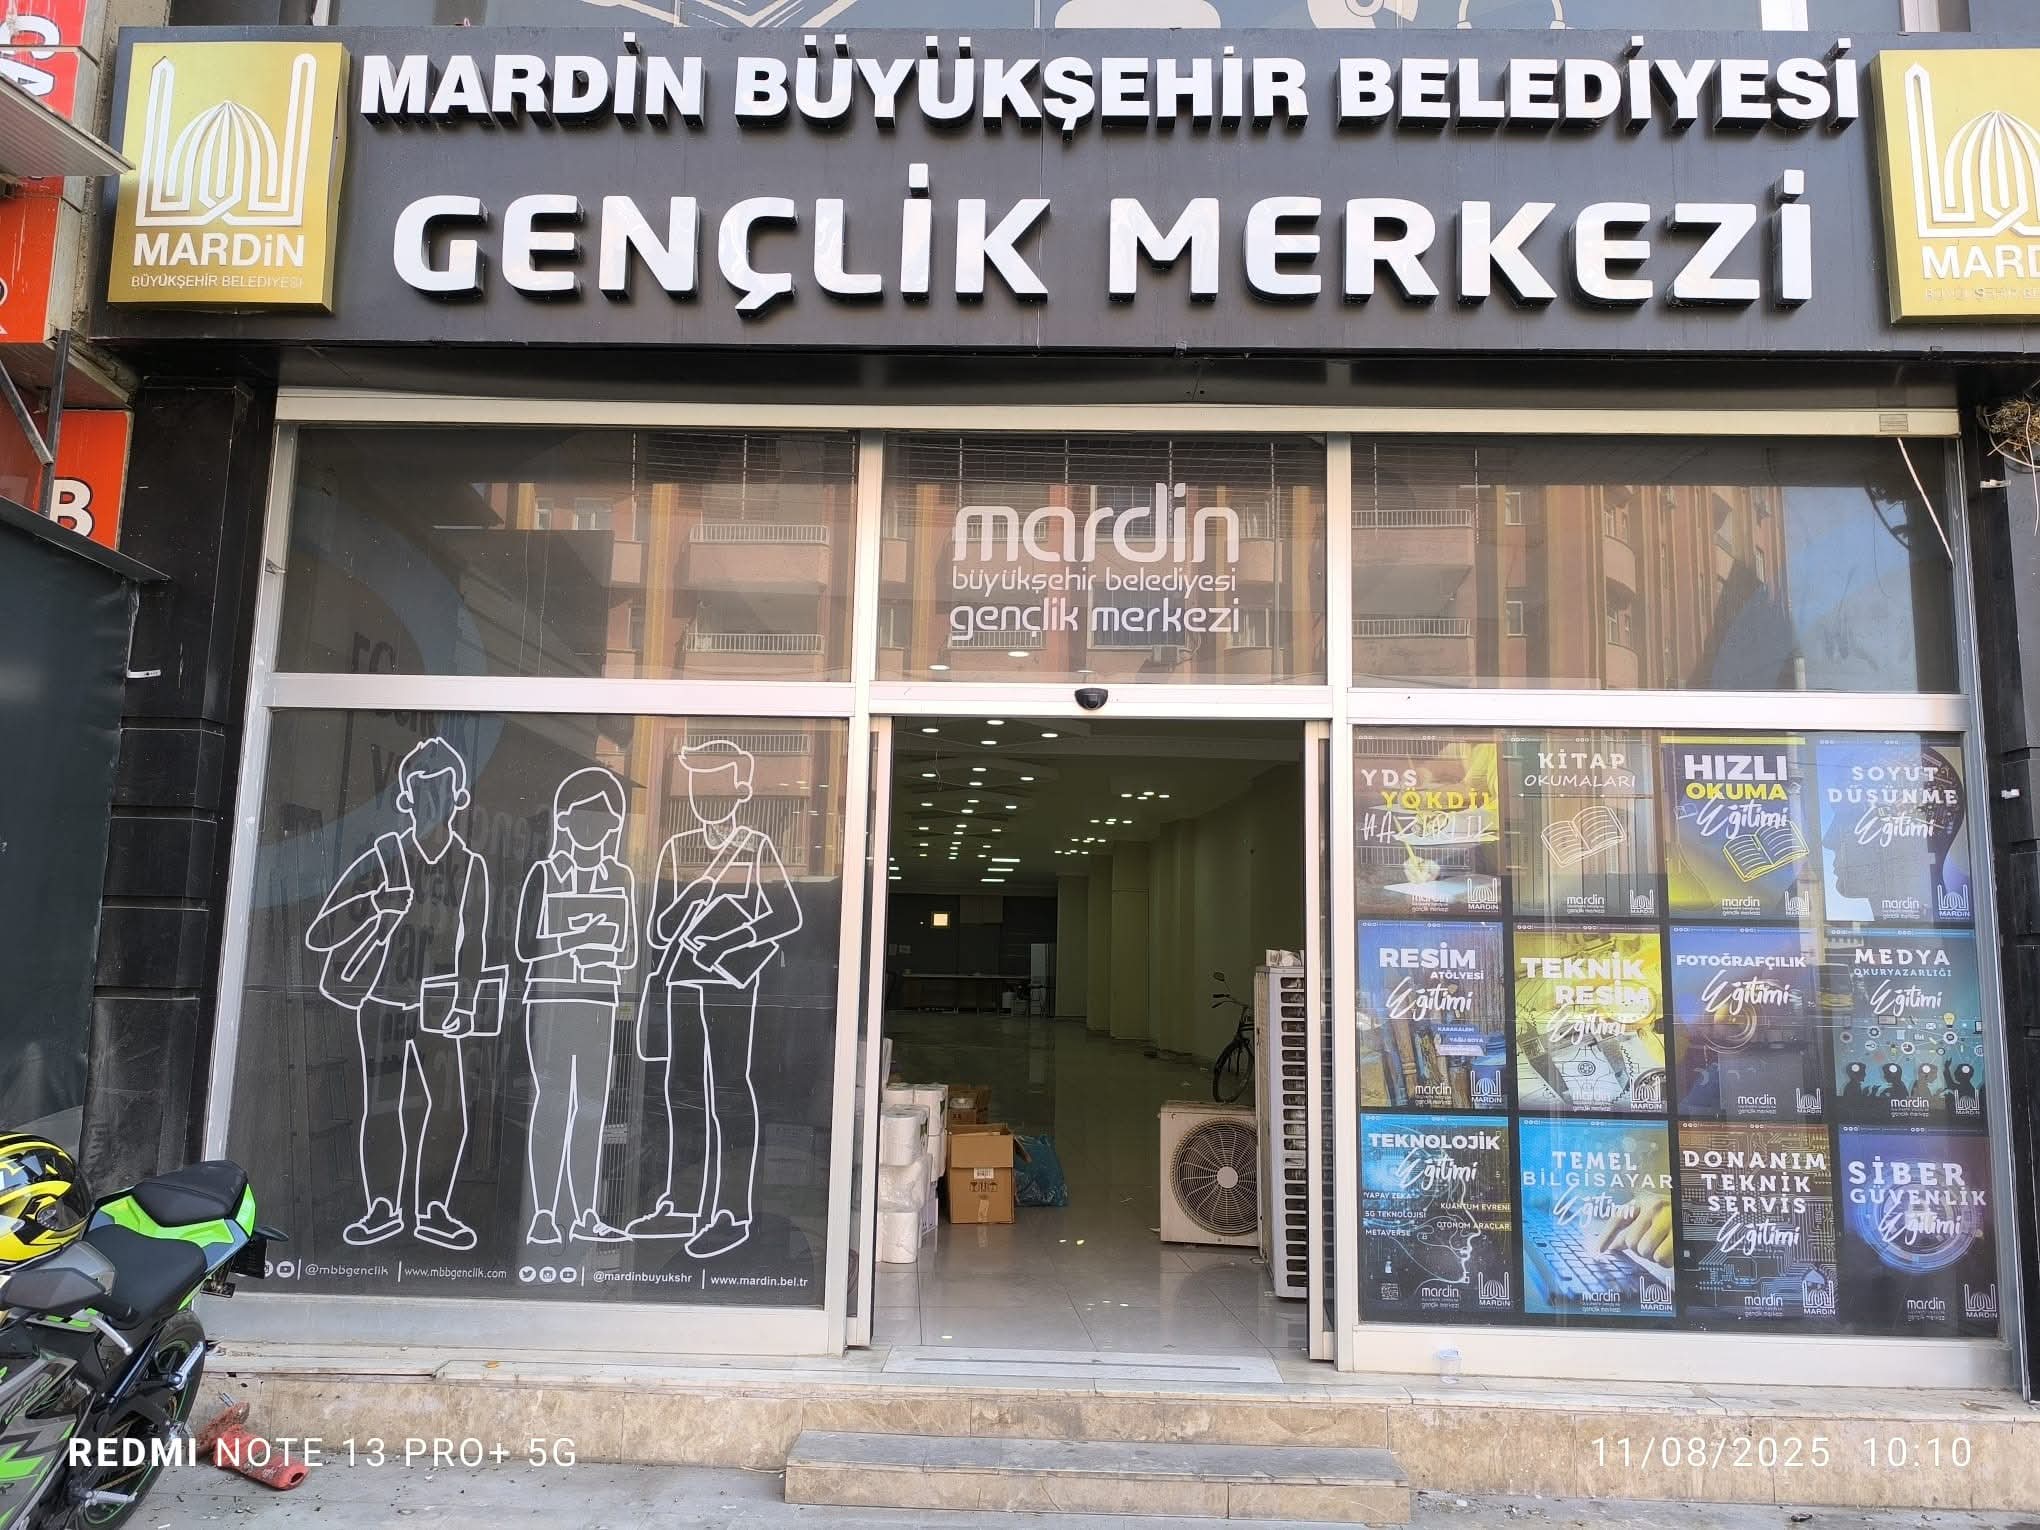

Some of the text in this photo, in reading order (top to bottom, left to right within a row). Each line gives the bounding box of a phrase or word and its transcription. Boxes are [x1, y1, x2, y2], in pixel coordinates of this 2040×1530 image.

[360, 31, 1859, 131] MARDİN BÜYÜKŞEHİR BELEDİYESİ
[393, 163, 1813, 314] GENÇLİK MERKEZİ
[131, 272, 218, 289] BÜYÜKŞEHİR
[952, 482, 1240, 563] mardin
[952, 566, 1237, 599] büyükşehir belediyesi
[950, 597, 1240, 640] gençlik merkezi
[1538, 748, 1627, 770] KİTAP
[1684, 754, 1789, 781] HIZLI
[1361, 769, 1418, 787] YDS
[1524, 774, 1636, 788] OKUMALARI
[1851, 766, 1939, 782] SOYUT
[1686, 782, 1790, 801] OKUMA
[1696, 797, 1790, 840] Eğitimi
[1855, 805, 1935, 848] Eğitimi
[1566, 893, 1605, 905] mardin
[1721, 896, 1761, 908] mardin
[1379, 941, 1476, 969] RESİM
[1520, 951, 1646, 980] TEKNİK
[1676, 952, 1807, 971] FOTOĞRAFÇILIK
[1854, 948, 1951, 966] MEDYA
[1429, 969, 1485, 981] ATÖLYESİ
[1853, 967, 1953, 978] OKURYAZARLIĞI
[1386, 976, 1473, 1023] Eğitimi
[1555, 981, 1651, 1008] RESİM
[1701, 969, 1792, 1016] Eğitimi
[1869, 979, 1943, 1018] Eğitimi
[1737, 1094, 1777, 1105] mardin
[1890, 1098, 1930, 1109] mardin
[1368, 1131, 1501, 1150] TEKNOLOJİK
[1395, 1148, 1479, 1191] Eğitimi
[1551, 1150, 1638, 1171] TEMEL
[1683, 1150, 1827, 1170] DONANIM
[1523, 1167, 1673, 1189] BİLGİSAYAR
[1848, 1155, 1966, 1187] SİBER
[1701, 1172, 1812, 1193] TEKNİK
[1707, 1193, 1807, 1215] SERVİS
[1849, 1185, 1988, 1207] GÜVENLİK
[1716, 1212, 1800, 1255] Eğitimi
[592, 1270, 693, 1284] @mardinbuyukshr
[710, 1274, 809, 1288] www.mardin.bel.tr
[1421, 1286, 1460, 1298] mardin
[1744, 1294, 1784, 1306] mardin
[1906, 1297, 1946, 1310] mardin
